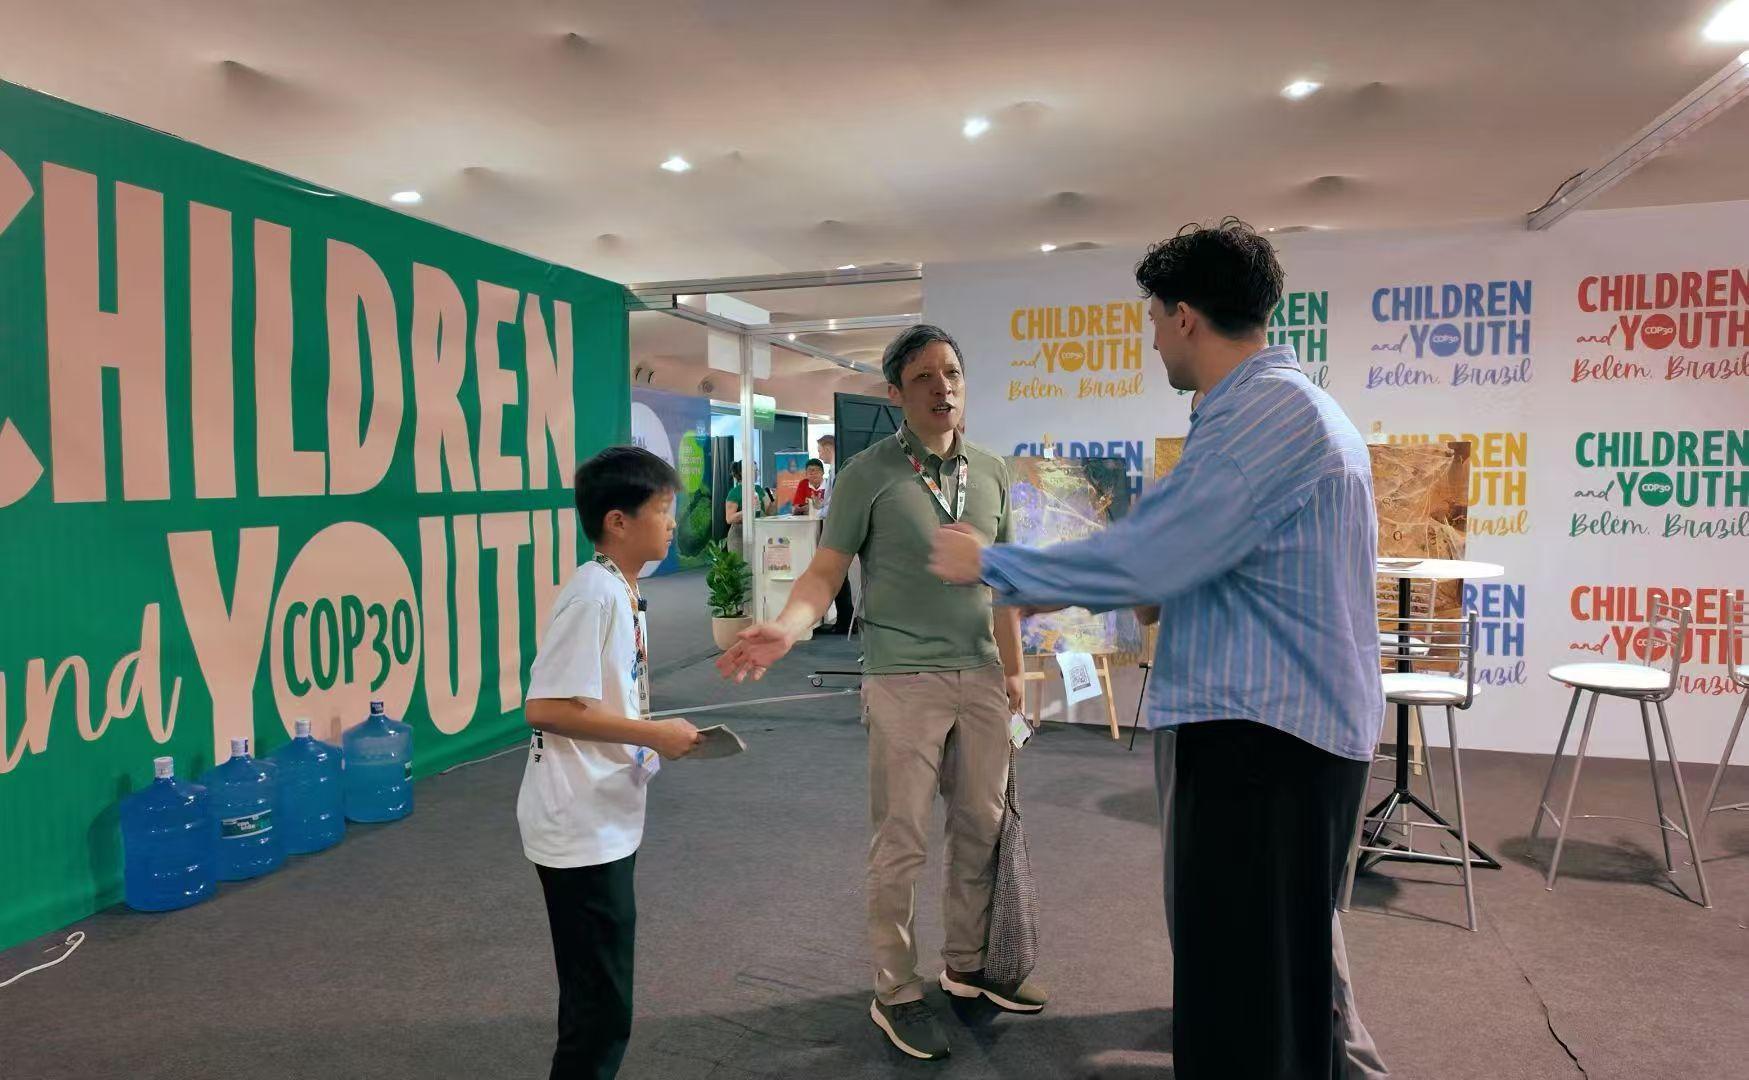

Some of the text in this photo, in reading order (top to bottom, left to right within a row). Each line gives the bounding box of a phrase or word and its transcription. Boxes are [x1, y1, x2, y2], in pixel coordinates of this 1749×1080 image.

[1372, 280, 1532, 322] CHILDREN
[1578, 269, 1749, 312] CHILDREN
[0, 149, 576, 507] HILDREN
[1011, 302, 1143, 340] CHILDREN
[1371, 320, 1530, 358] and YOUTH
[1577, 310, 1749, 350] and YOUTH
[1041, 338, 1142, 373] YOUTH
[1451, 358, 1533, 387] Brazil
[1665, 352, 1749, 380] Brazil
[1078, 372, 1144, 399] Brazil
[1576, 430, 1749, 467] CHILDREN
[1574, 471, 1749, 507] and YOUTH
[1662, 511, 1749, 539] Brazil
[283, 595, 414, 697] COP30
[1569, 634, 1610, 655] and
[0, 602, 182, 774] nd
